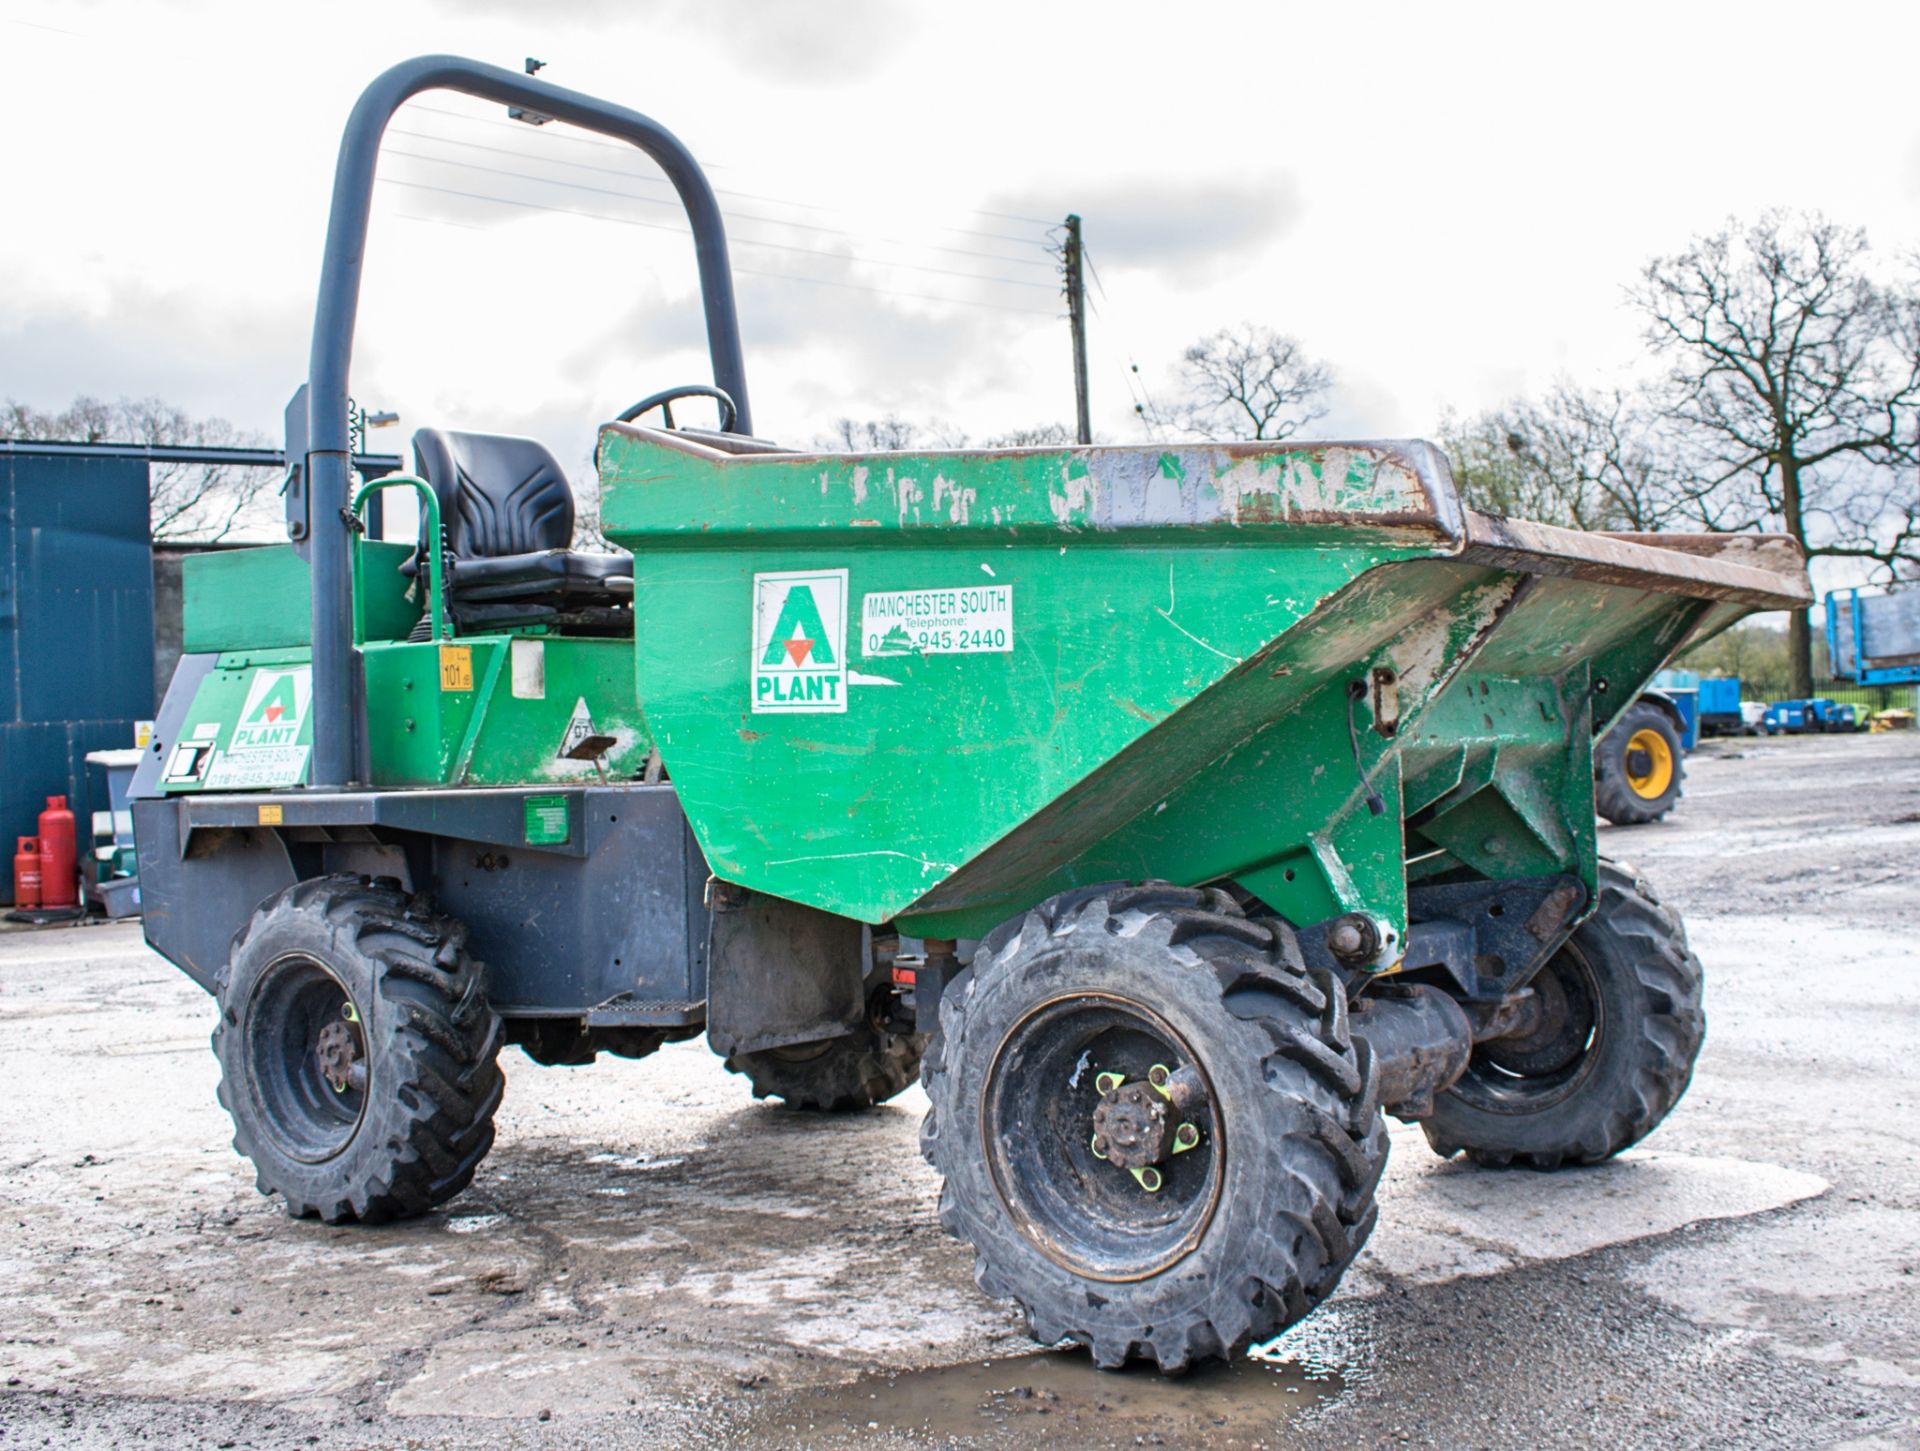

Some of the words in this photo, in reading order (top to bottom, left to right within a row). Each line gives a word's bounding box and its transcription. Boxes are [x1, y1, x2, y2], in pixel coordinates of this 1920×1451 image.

[868, 593, 956, 617] MANCHESTER
[960, 590, 1006, 613] SOUTH
[761, 585, 836, 665] A
[905, 616, 967, 629] Telephone:
[445, 664, 460, 686] 101
[245, 675, 297, 723] A
[757, 676, 840, 701] PLANT
[234, 728, 296, 745] PLANT
